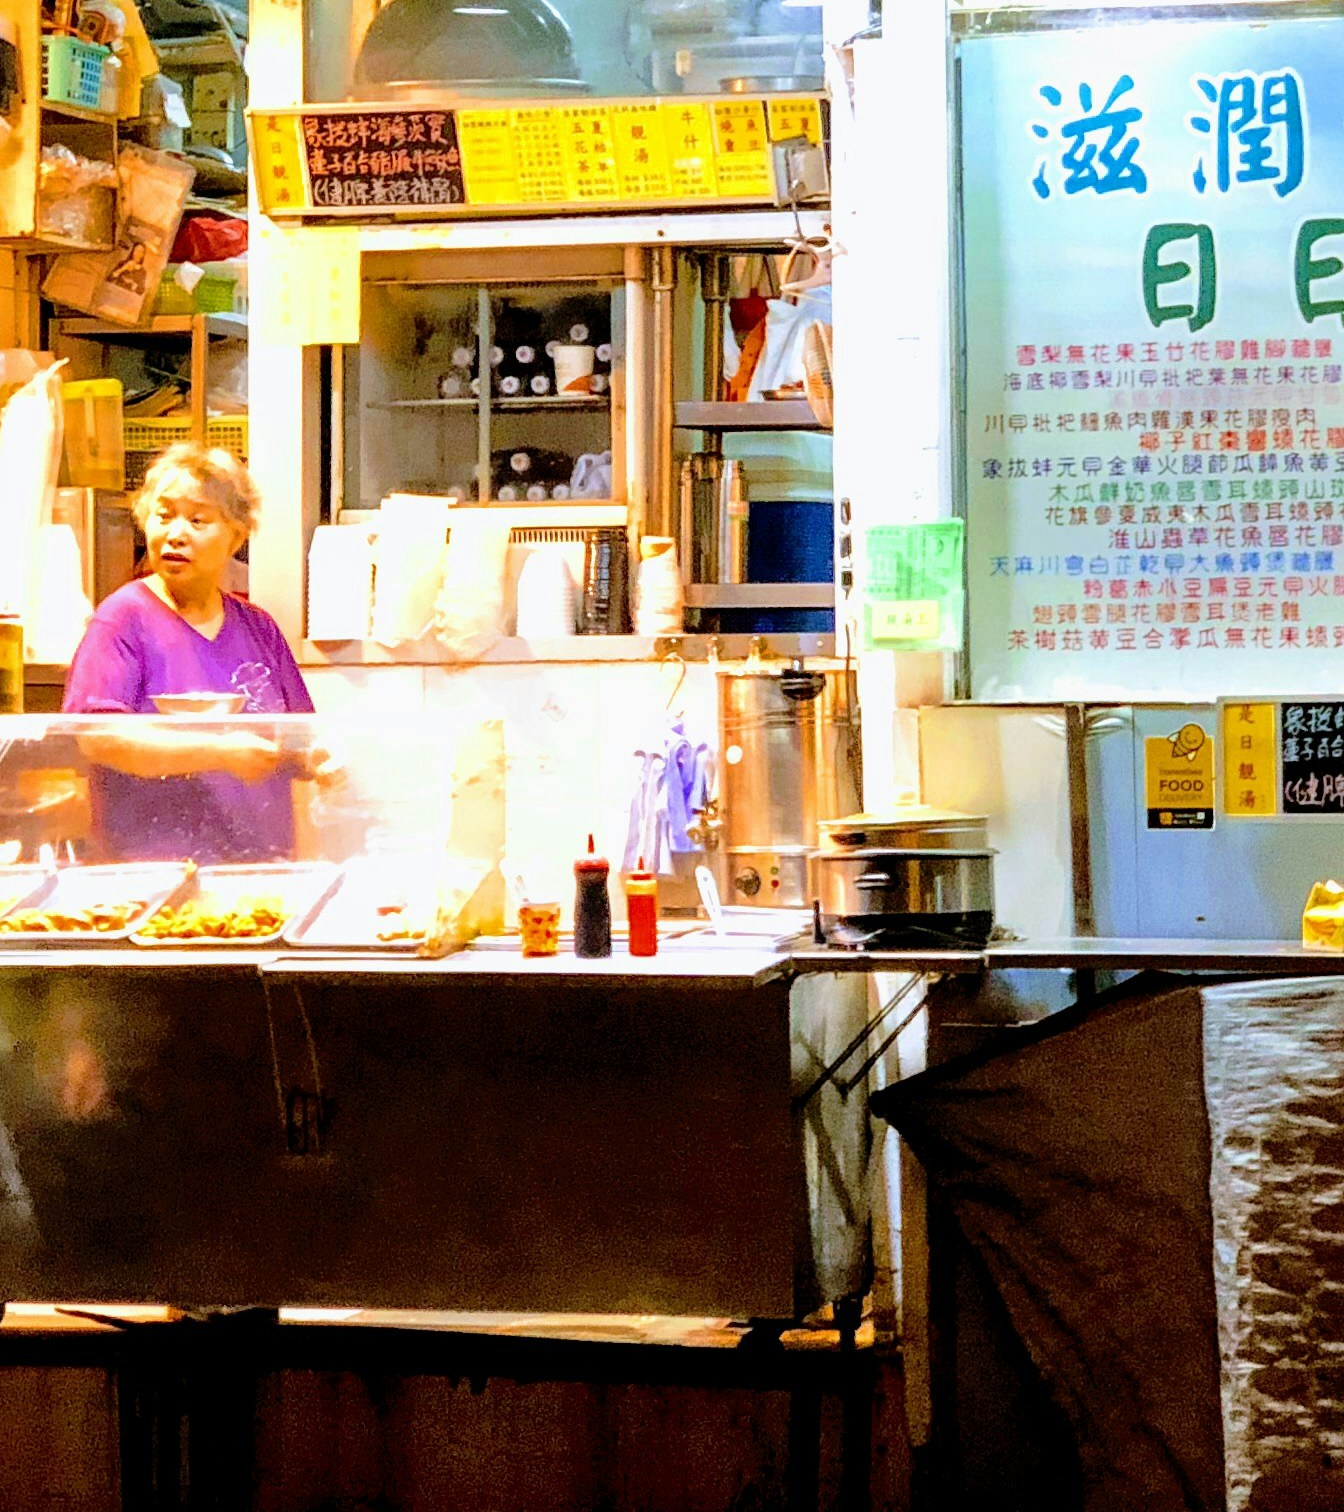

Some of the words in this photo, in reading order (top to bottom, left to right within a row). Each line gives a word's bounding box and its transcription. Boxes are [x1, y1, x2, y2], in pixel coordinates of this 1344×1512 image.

[1159, 779, 1204, 792] FOOD
[1237, 703, 1258, 810] 是日靚湯
